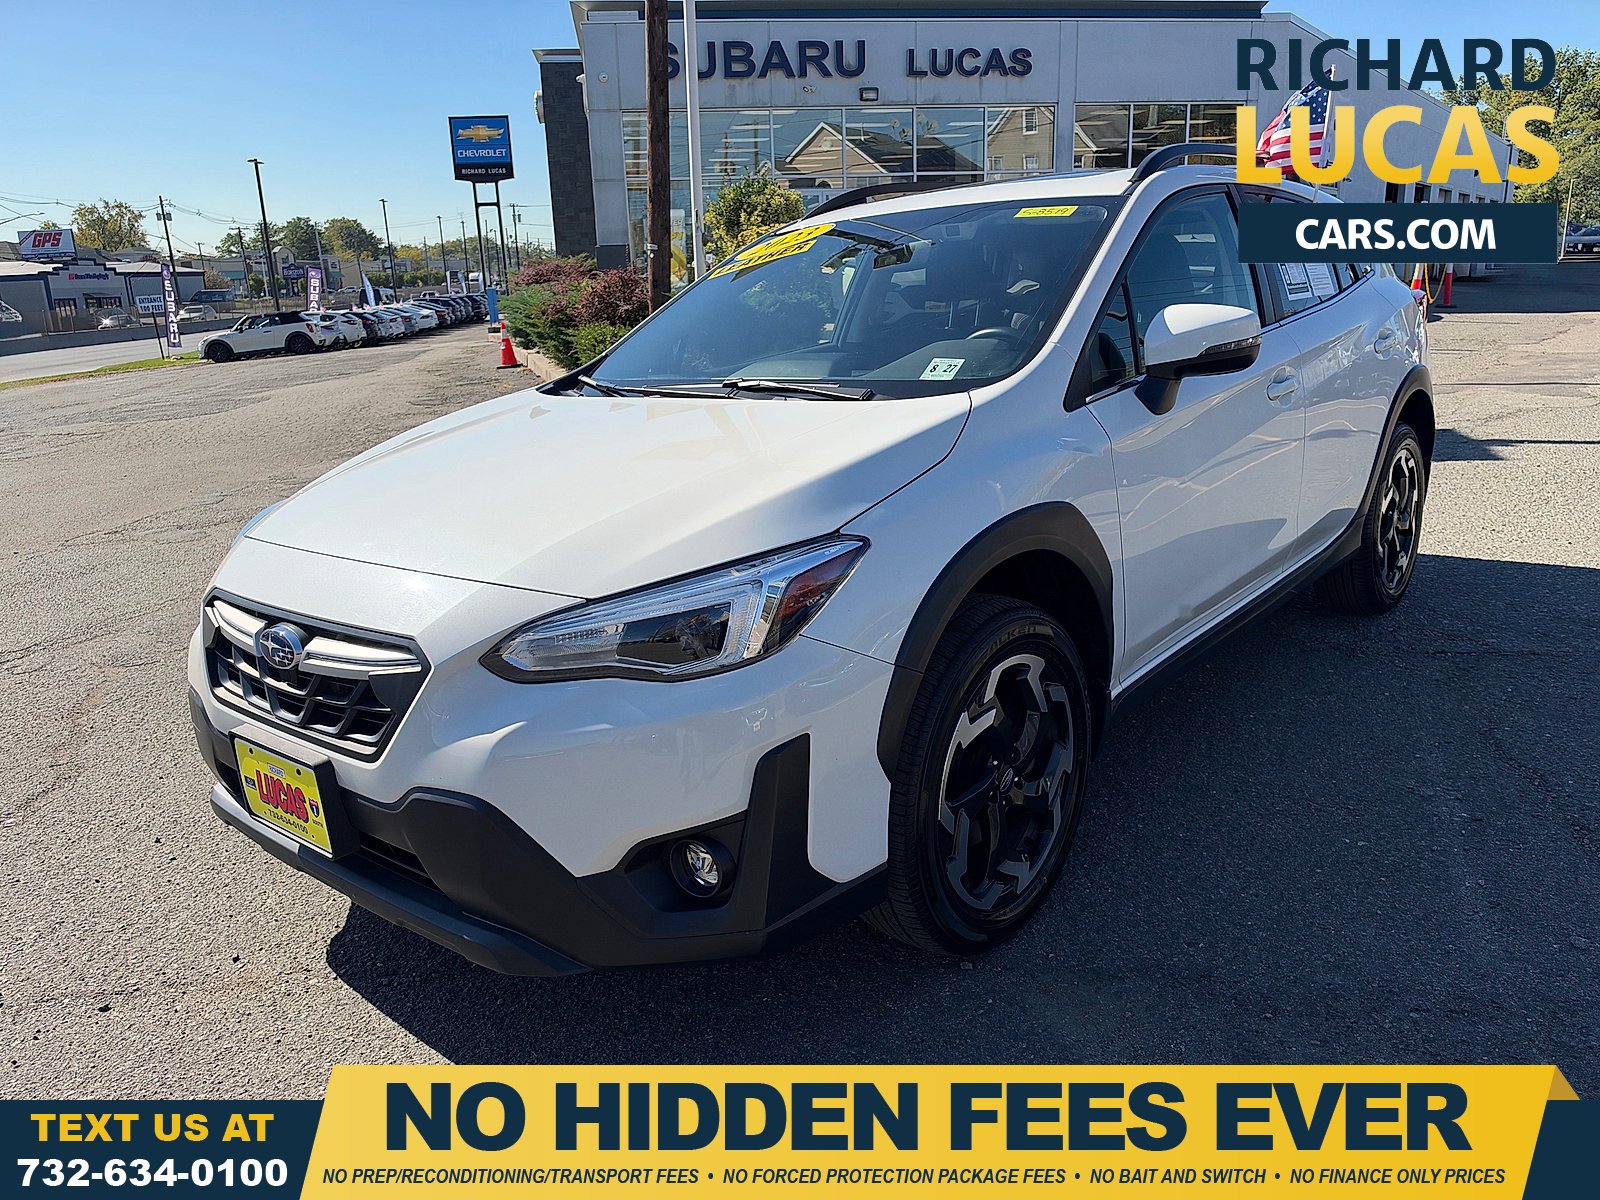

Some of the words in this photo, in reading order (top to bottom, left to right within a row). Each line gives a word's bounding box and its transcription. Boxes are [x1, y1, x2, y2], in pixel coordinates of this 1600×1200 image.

[906, 47, 1033, 77] LUCAS
[457, 148, 507, 157] CHEVROLET
[31, 231, 63, 248] GPS
[138, 296, 163, 304] ENTRANCE
[152, 304, 164, 312] FEET
[164, 280, 179, 343] SUBARU
[942, 364, 959, 373] 27
[255, 769, 310, 824] LUCAS
